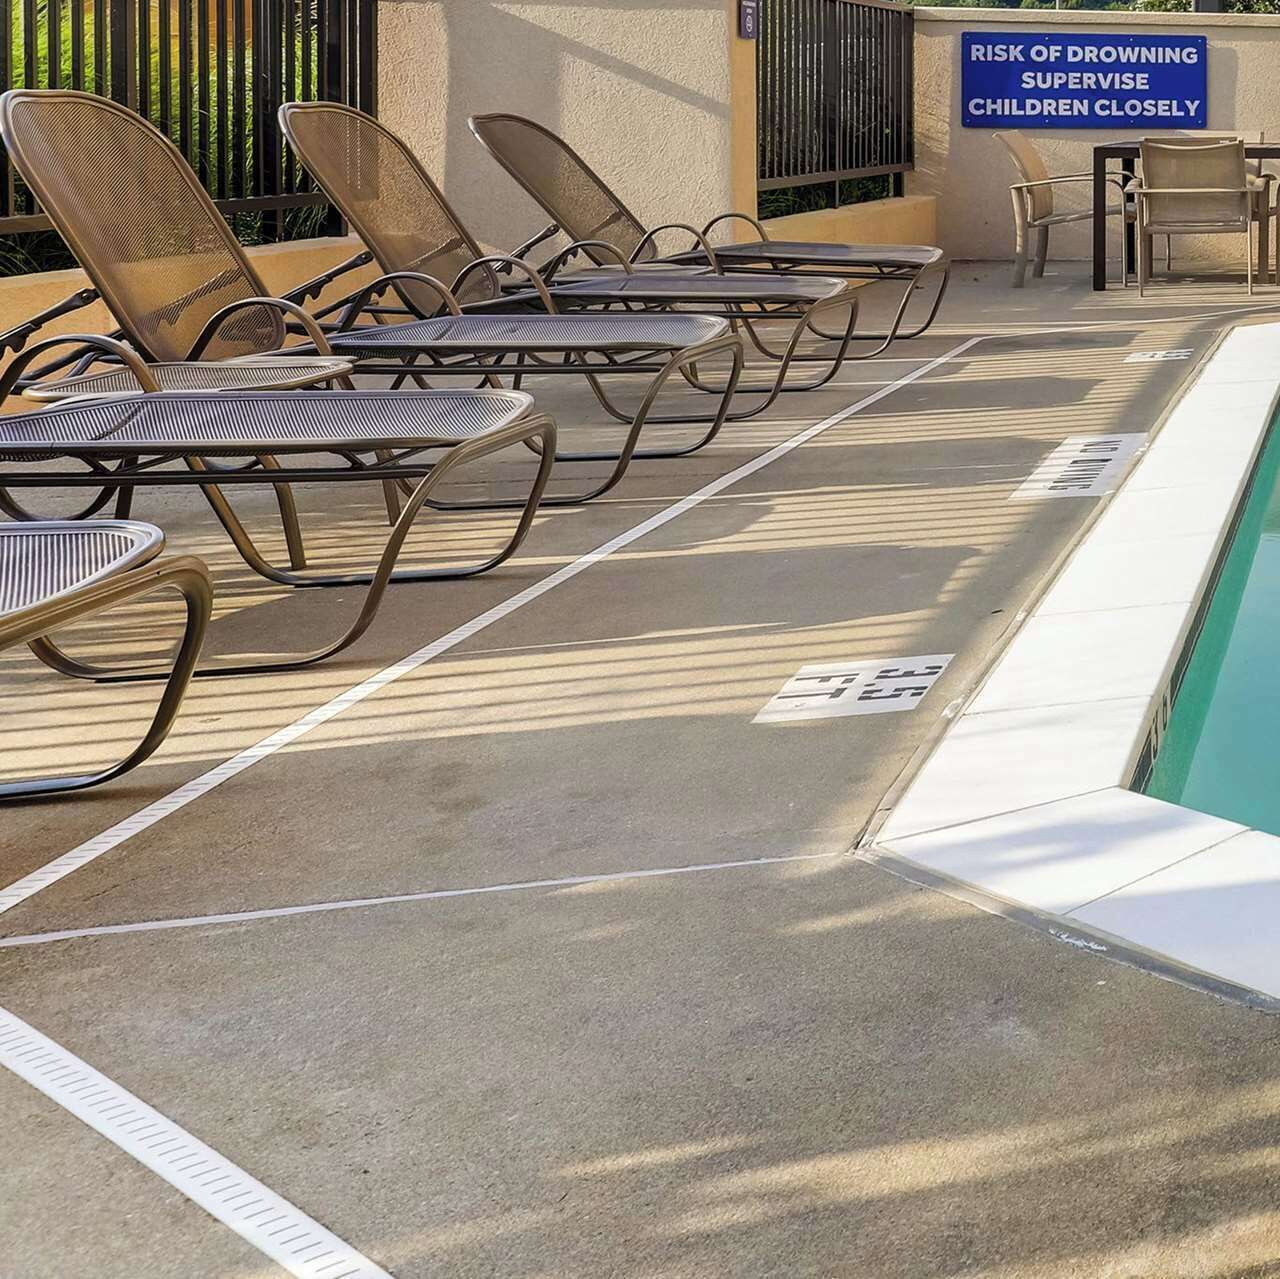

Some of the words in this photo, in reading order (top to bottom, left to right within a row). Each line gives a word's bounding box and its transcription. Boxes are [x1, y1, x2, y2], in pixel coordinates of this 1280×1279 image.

[970, 44, 1025, 63] RISK
[1031, 45, 1062, 63] OF
[1067, 45, 1199, 65] DROWNING
[1020, 71, 1150, 91] SUPERVISE
[968, 98, 1090, 117] CHILDREN
[1094, 99, 1200, 118] CLOSELY
[1079, 439, 1122, 453] NO
[1047, 458, 1113, 491] DIVING
[776, 672, 861, 701] FT
[856, 665, 944, 702] 3.5
